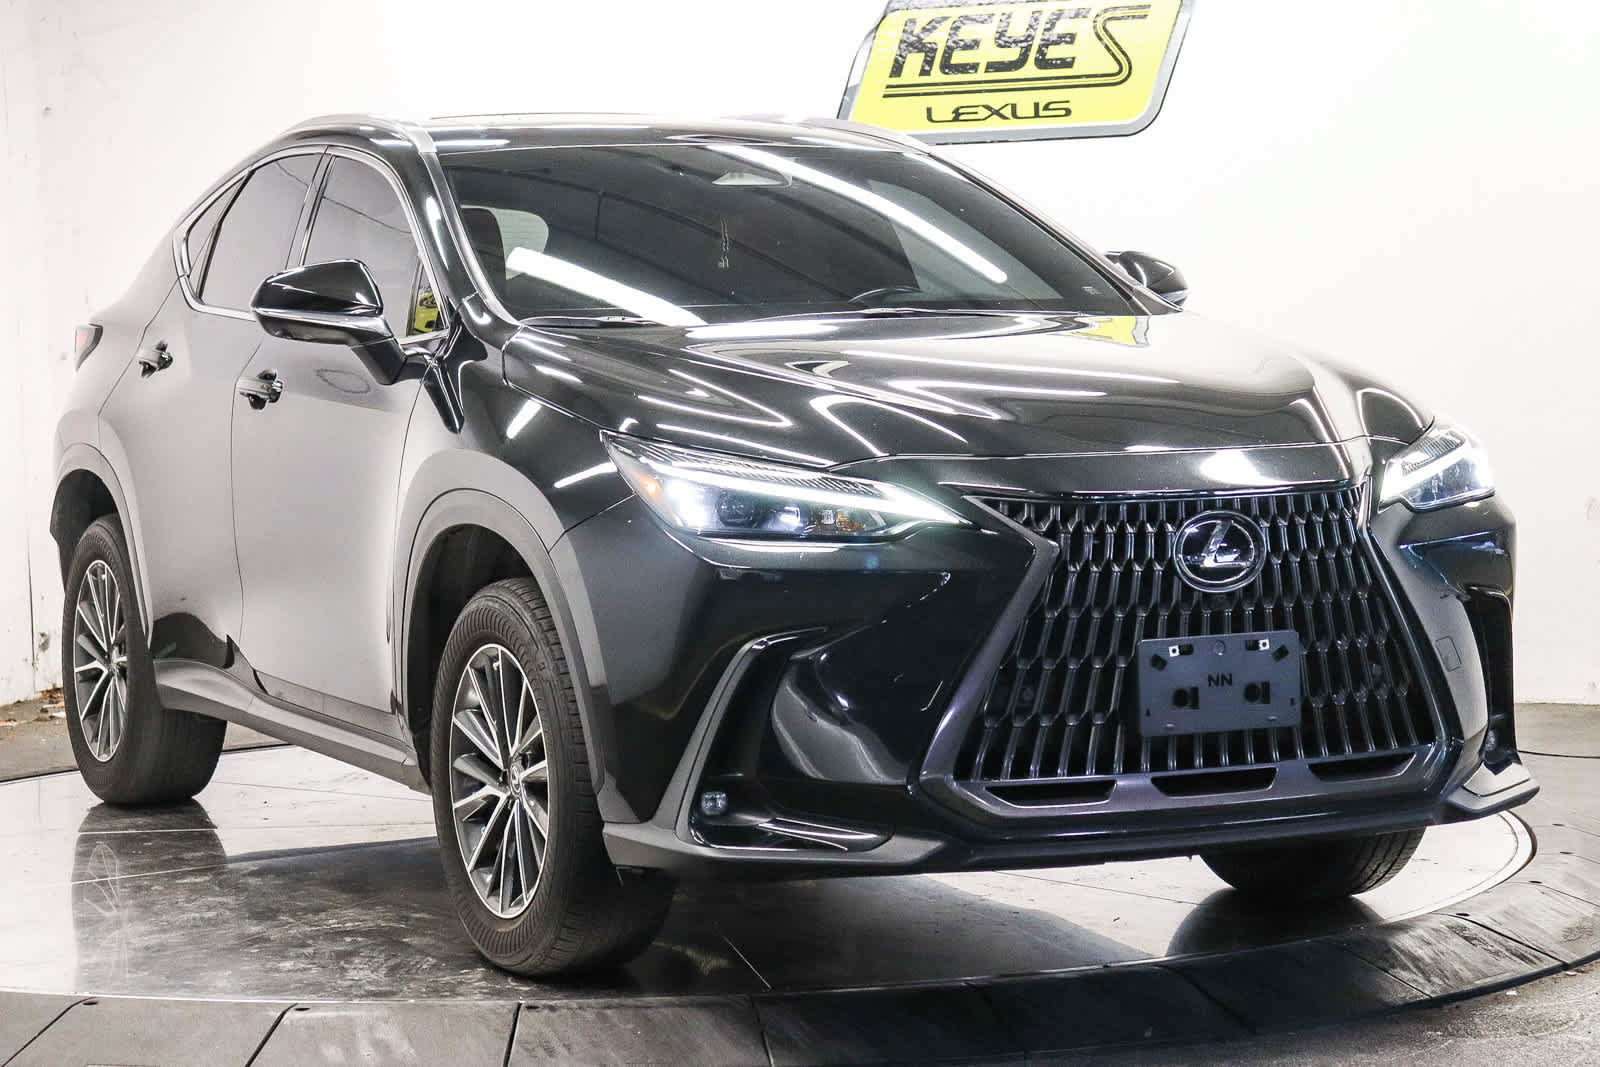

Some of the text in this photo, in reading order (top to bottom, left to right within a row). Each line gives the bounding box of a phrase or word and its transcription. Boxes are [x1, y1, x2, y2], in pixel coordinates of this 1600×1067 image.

[885, 4, 1152, 88] KEYES
[926, 100, 1073, 123] LEXUS
[1207, 672, 1233, 687] NN
